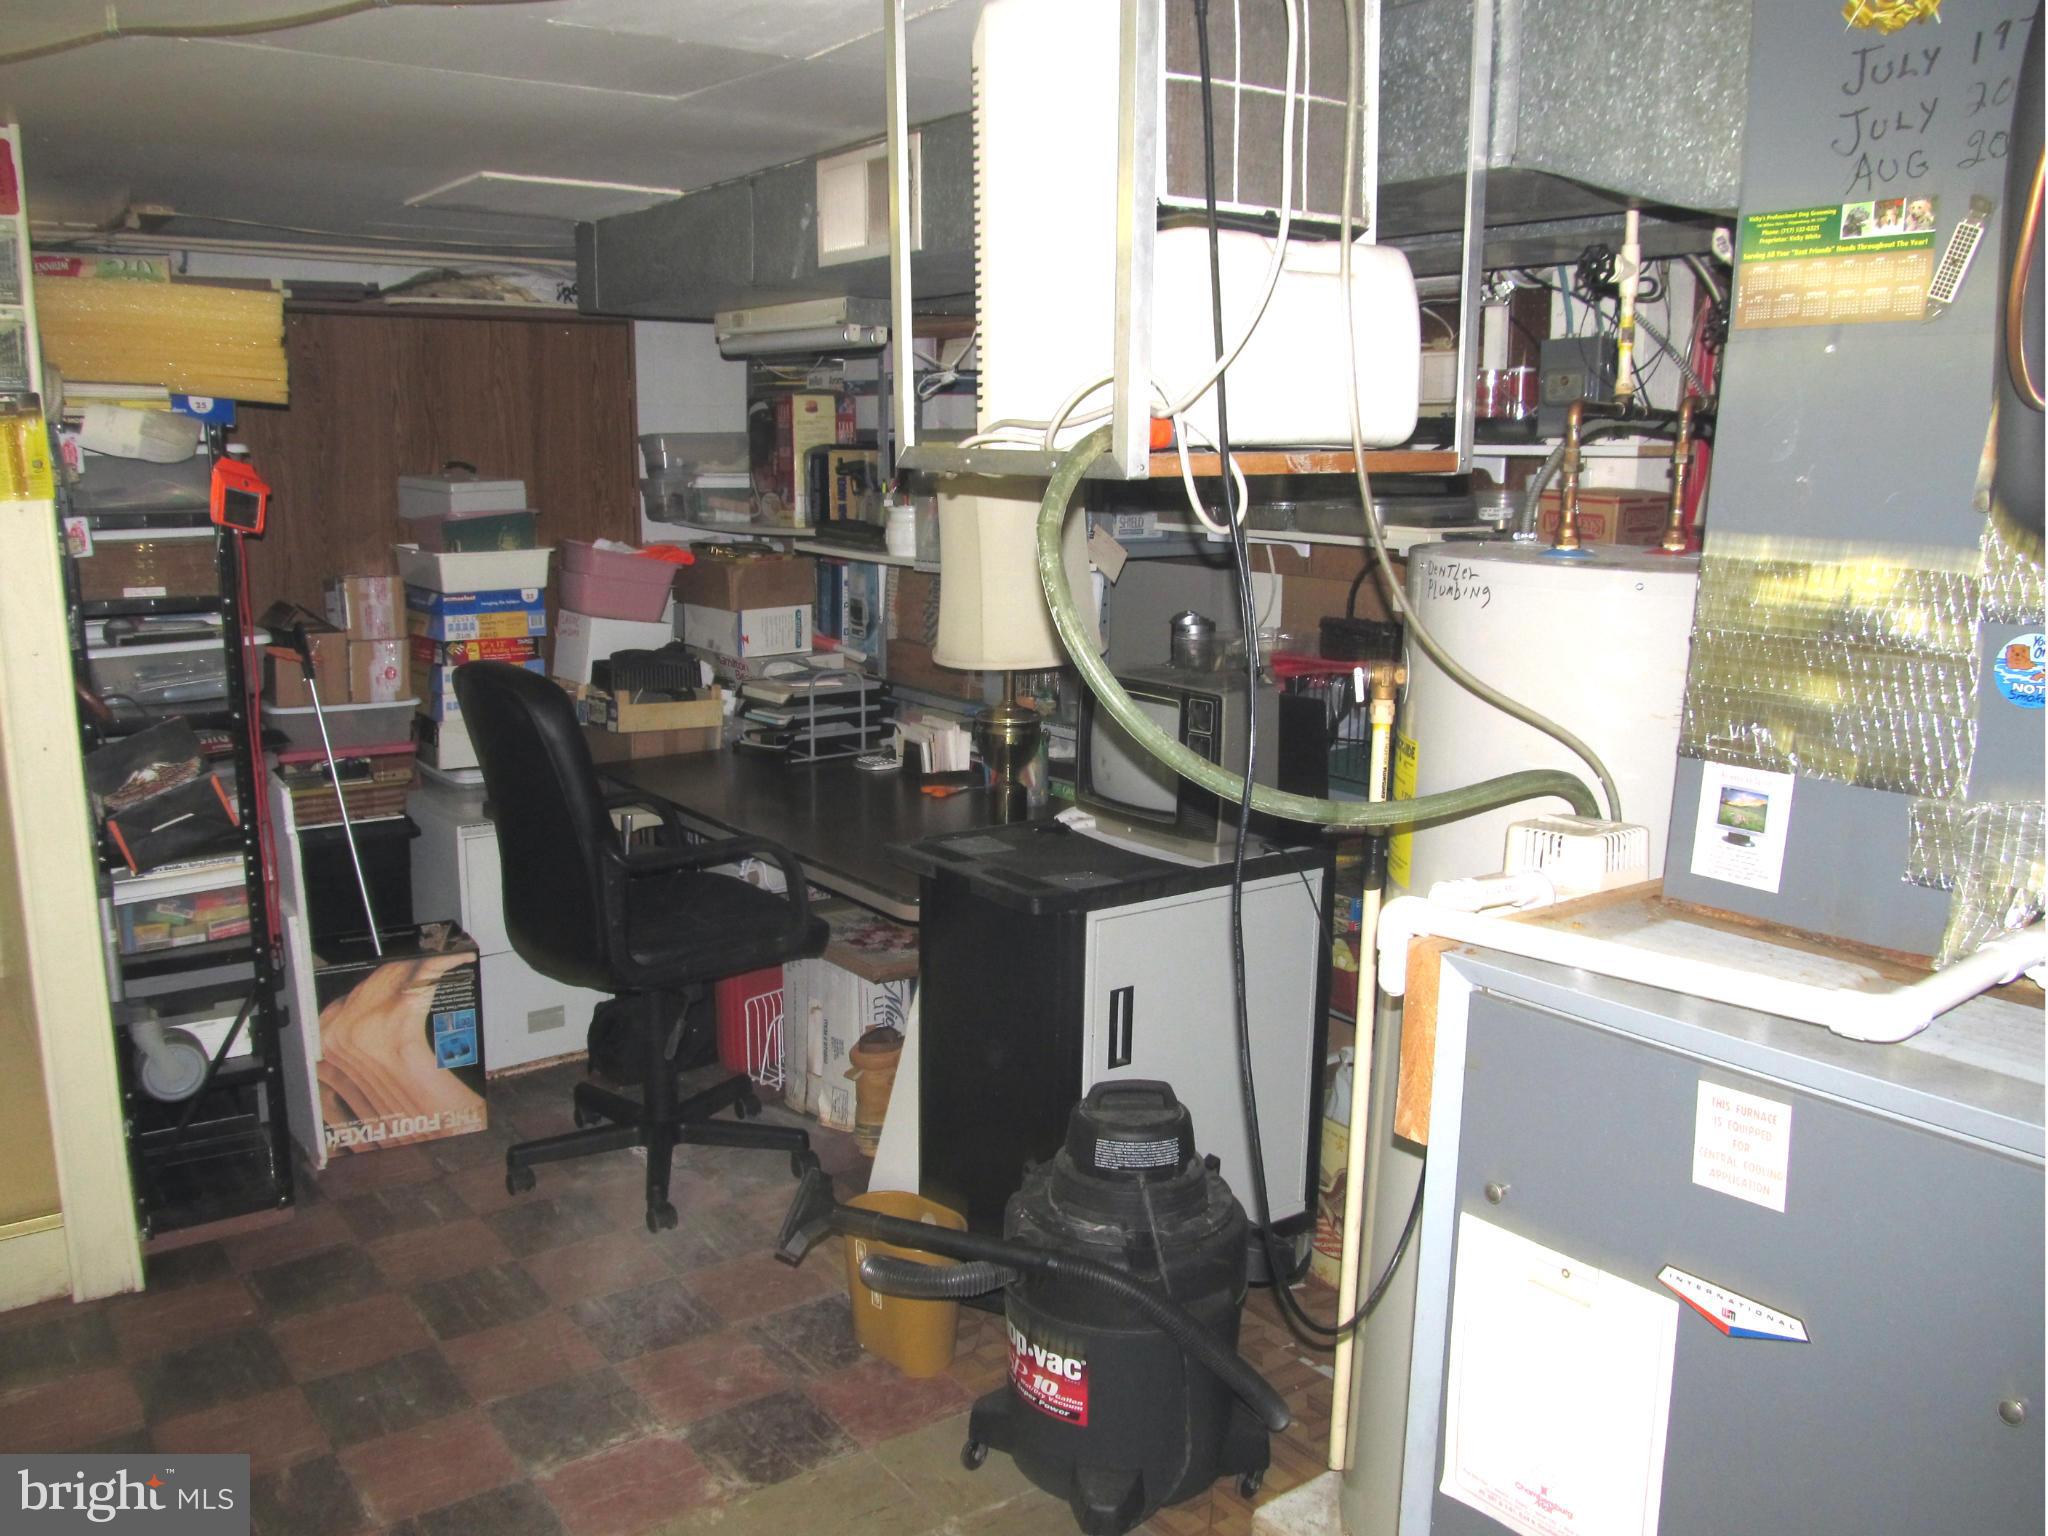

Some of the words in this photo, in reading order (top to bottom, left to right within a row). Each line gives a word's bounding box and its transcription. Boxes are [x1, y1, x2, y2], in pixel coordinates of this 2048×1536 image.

[1841, 45, 1941, 96] JULY
[1831, 97, 1939, 156] JULY
[1845, 150, 1930, 196] AUG
[1767, 211, 1798, 220] Professional
[1799, 209, 1811, 219] Dog
[1856, 240, 1896, 251] Throughout
[1896, 238, 1909, 248] The
[195, 401, 207, 410] 25
[1119, 515, 1144, 529] SHIELD
[2012, 682, 2046, 694] NOT
[1712, 1096, 1731, 1112] THIS
[1736, 1104, 1778, 1126] FURNACE
[325, 1121, 387, 1149] FIXER
[388, 1112, 441, 1138] FOOT
[1727, 1119, 1772, 1142] EQUIPPED
[1732, 1139, 1751, 1153] FOR
[1708, 1168, 1771, 1195] APPLICATION
[1668, 1273, 1795, 1330] INTERNATIONAL
[1032, 1373, 1059, 1397] 10
[1038, 1400, 1071, 1417] Power
[1048, 1395, 1084, 1412] Vacuum
